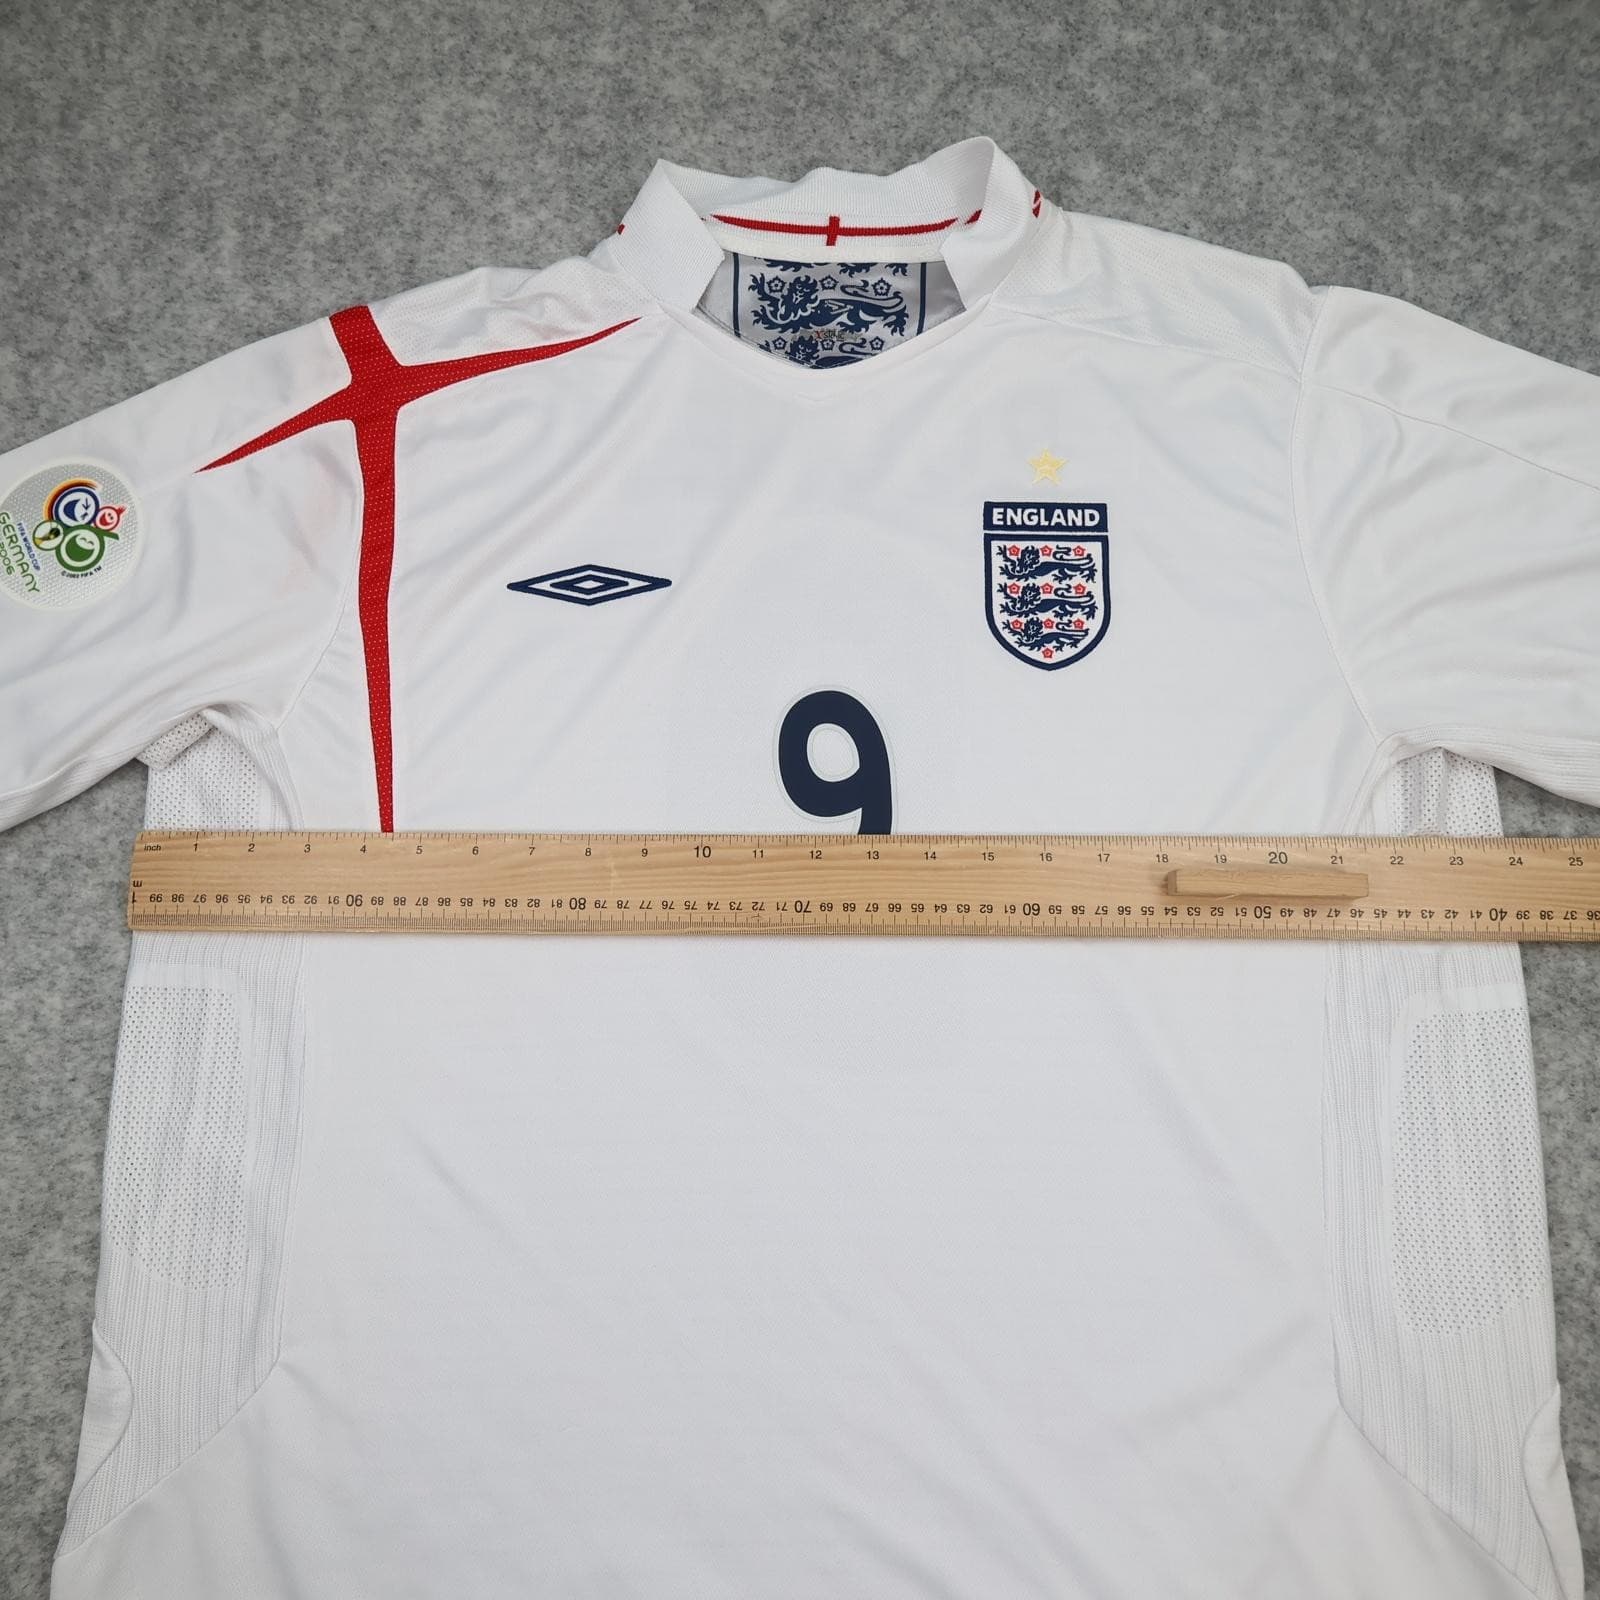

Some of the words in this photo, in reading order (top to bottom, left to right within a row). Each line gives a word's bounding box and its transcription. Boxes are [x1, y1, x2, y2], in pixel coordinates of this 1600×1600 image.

[992, 507, 1101, 527] ENGLAND
[0, 512, 40, 593] GERMANY
[23, 537, 35, 559] WORLD
[32, 559, 41, 571] CUP
[0, 542, 16, 576] 2006
[778, 690, 893, 835] 9
[144, 843, 161, 851] inch
[192, 844, 200, 853] 1
[248, 844, 256, 853] 2
[304, 844, 310, 854] 3
[360, 845, 366, 854] 4
[416, 846, 422, 855] 5
[472, 846, 478, 856] 6
[528, 847, 536, 856] 7
[584, 848, 592, 857] 8
[642, 849, 648, 858] 9
[693, 847, 712, 859] 10
[752, 850, 764, 859] 11
[810, 851, 822, 860] 12
[866, 851, 880, 860] 13
[924, 852, 936, 861] 14
[982, 852, 994, 861] 15
[1040, 853, 1052, 862] 16
[1098, 853, 1110, 862] 17
[1156, 854, 1168, 863] 18
[1214, 854, 1228, 864] 19
[1267, 852, 1288, 864] 20
[1330, 856, 1344, 865] 21
[1390, 856, 1404, 865] 22
[1448, 856, 1464, 866] 23
[1508, 857, 1524, 866] 24
[1568, 857, 1584, 866] 25
[150, 894, 162, 903] 99
[172, 894, 184, 903] 98
[192, 894, 208, 904] 97
[216, 894, 228, 904] 96
[238, 894, 250, 904] 95
[260, 895, 272, 904] 94
[282, 895, 296, 904] 93
[304, 895, 318, 904] 92
[328, 895, 340, 905] 91
[346, 894, 364, 908] 90
[370, 896, 384, 906] 89
[392, 897, 406, 906] 88
[414, 897, 428, 906] 87
[438, 897, 452, 907] 86
[460, 898, 474, 907] 85
[482, 898, 496, 907] 84
[504, 898, 518, 908] 83
[526, 899, 540, 908] 82
[552, 899, 564, 908] 81
[568, 898, 586, 911] 80
[594, 900, 608, 909] 79
[616, 900, 630, 909] 78
[638, 900, 652, 910] 77
[662, 901, 676, 910] 76
[684, 901, 698, 910] 75
[706, 901, 720, 911] 74
[728, 902, 742, 911] 73
[752, 902, 766, 911] 72
[776, 902, 788, 911] 71
[794, 901, 812, 914] 70
[820, 903, 834, 912] 69
[842, 903, 856, 912] 68
[864, 903, 880, 912] 67
[888, 903, 902, 912] 66
[910, 903, 924, 913] 65
[934, 904, 948, 913] 64
[956, 904, 970, 913] 63
[980, 904, 994, 913] 62
[1004, 904, 1016, 914] 61
[1022, 903, 1040, 916] 60
[1048, 905, 1062, 914] 59
[1070, 905, 1086, 915] 58
[1094, 906, 1108, 915] 57
[1116, 906, 1132, 915] 56
[1140, 906, 1154, 915] 55
[1164, 906, 1178, 916] 54
[1186, 907, 1200, 916] 53
[1210, 907, 1224, 916] 52
[1236, 907, 1248, 917] 51
[1254, 906, 1272, 920] 50
[1280, 908, 1294, 918] 49
[1302, 908, 1318, 918] 48
[1326, 909, 1340, 918] 47
[1350, 909, 1364, 918] 46
[1374, 909, 1388, 918] 45
[1396, 909, 1412, 918] 44
[1420, 909, 1436, 919] 43
[1444, 910, 1460, 919] 42
[1470, 910, 1482, 919] 41
[1488, 908, 1508, 922] 40
[1516, 910, 1530, 919] 39
[1540, 910, 1554, 920] 38
[1562, 910, 1578, 920] 37
[1586, 910, 1600, 920] 36
